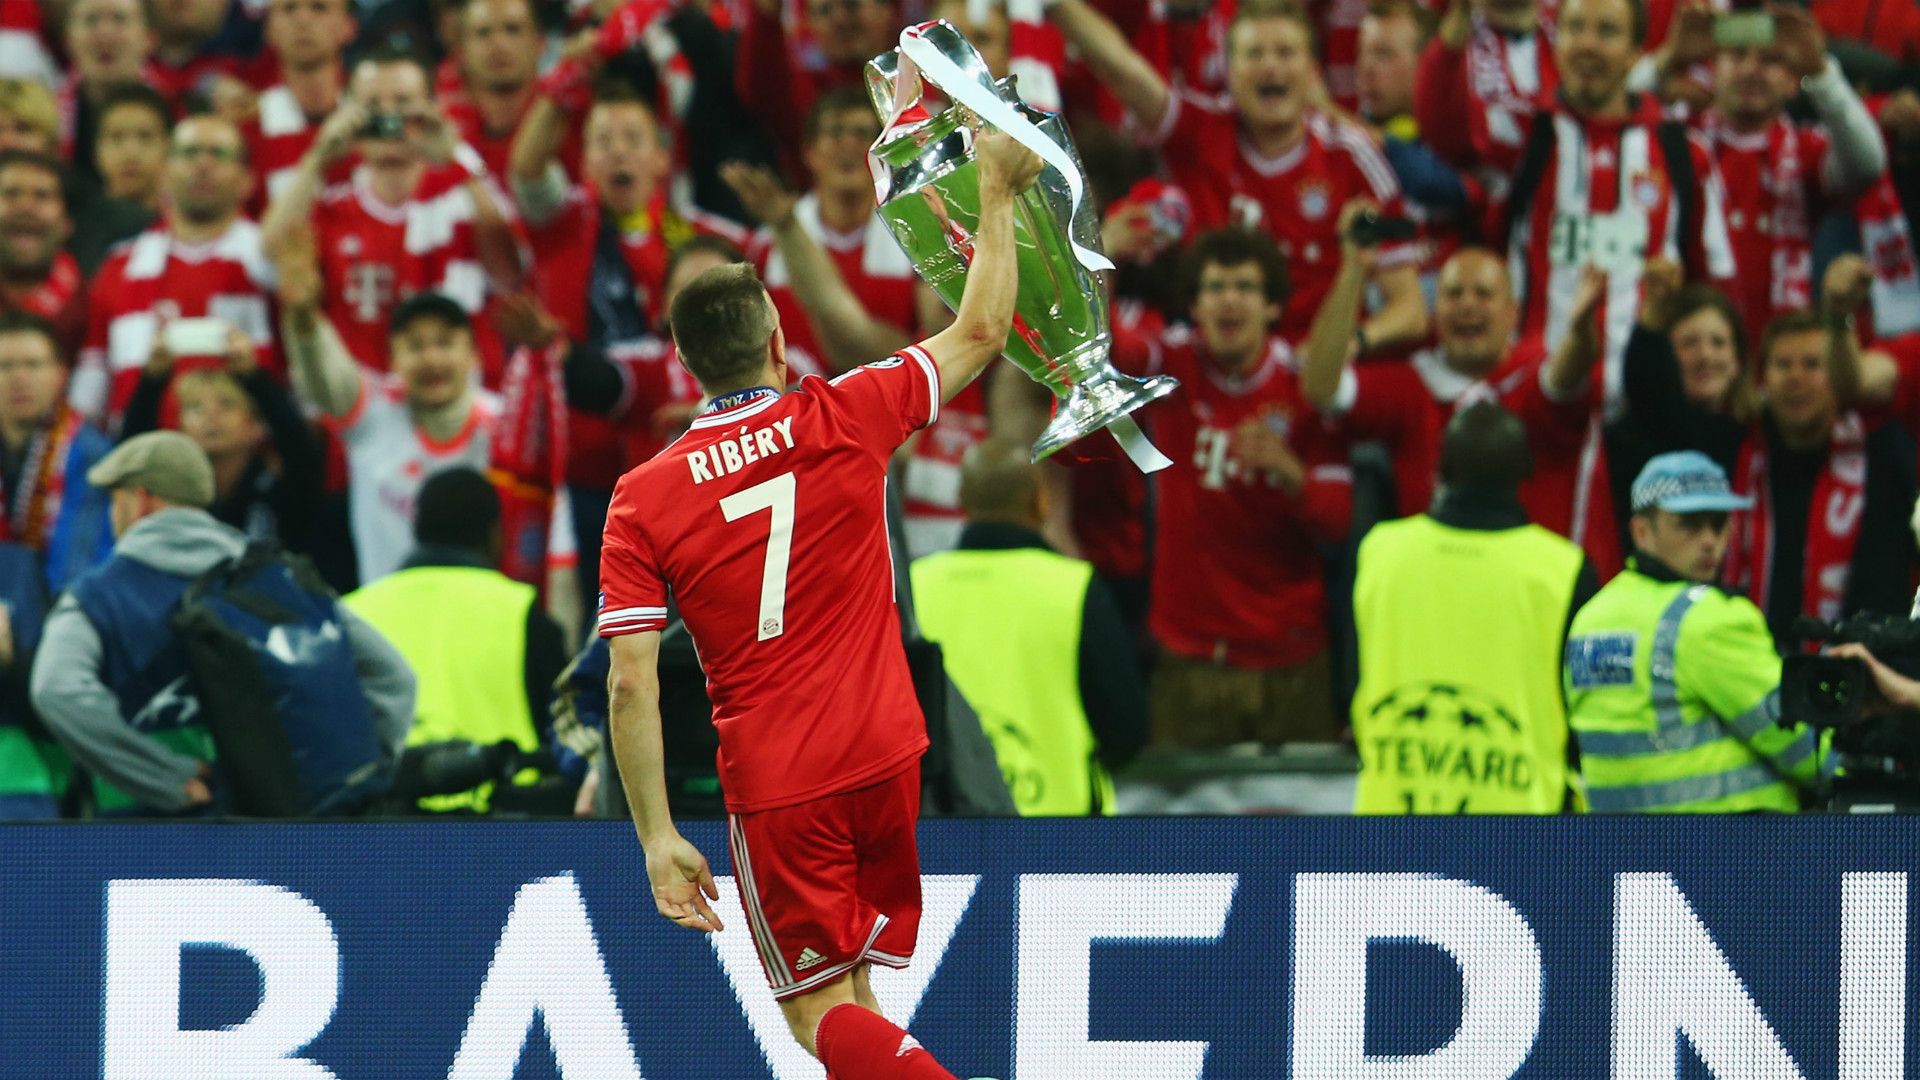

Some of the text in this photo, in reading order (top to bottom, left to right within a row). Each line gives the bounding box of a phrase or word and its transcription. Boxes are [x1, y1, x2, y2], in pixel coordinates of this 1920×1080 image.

[686, 416, 795, 485] RIBÉRY
[718, 471, 796, 642] 7
[1371, 737, 1532, 794] TEWARD
